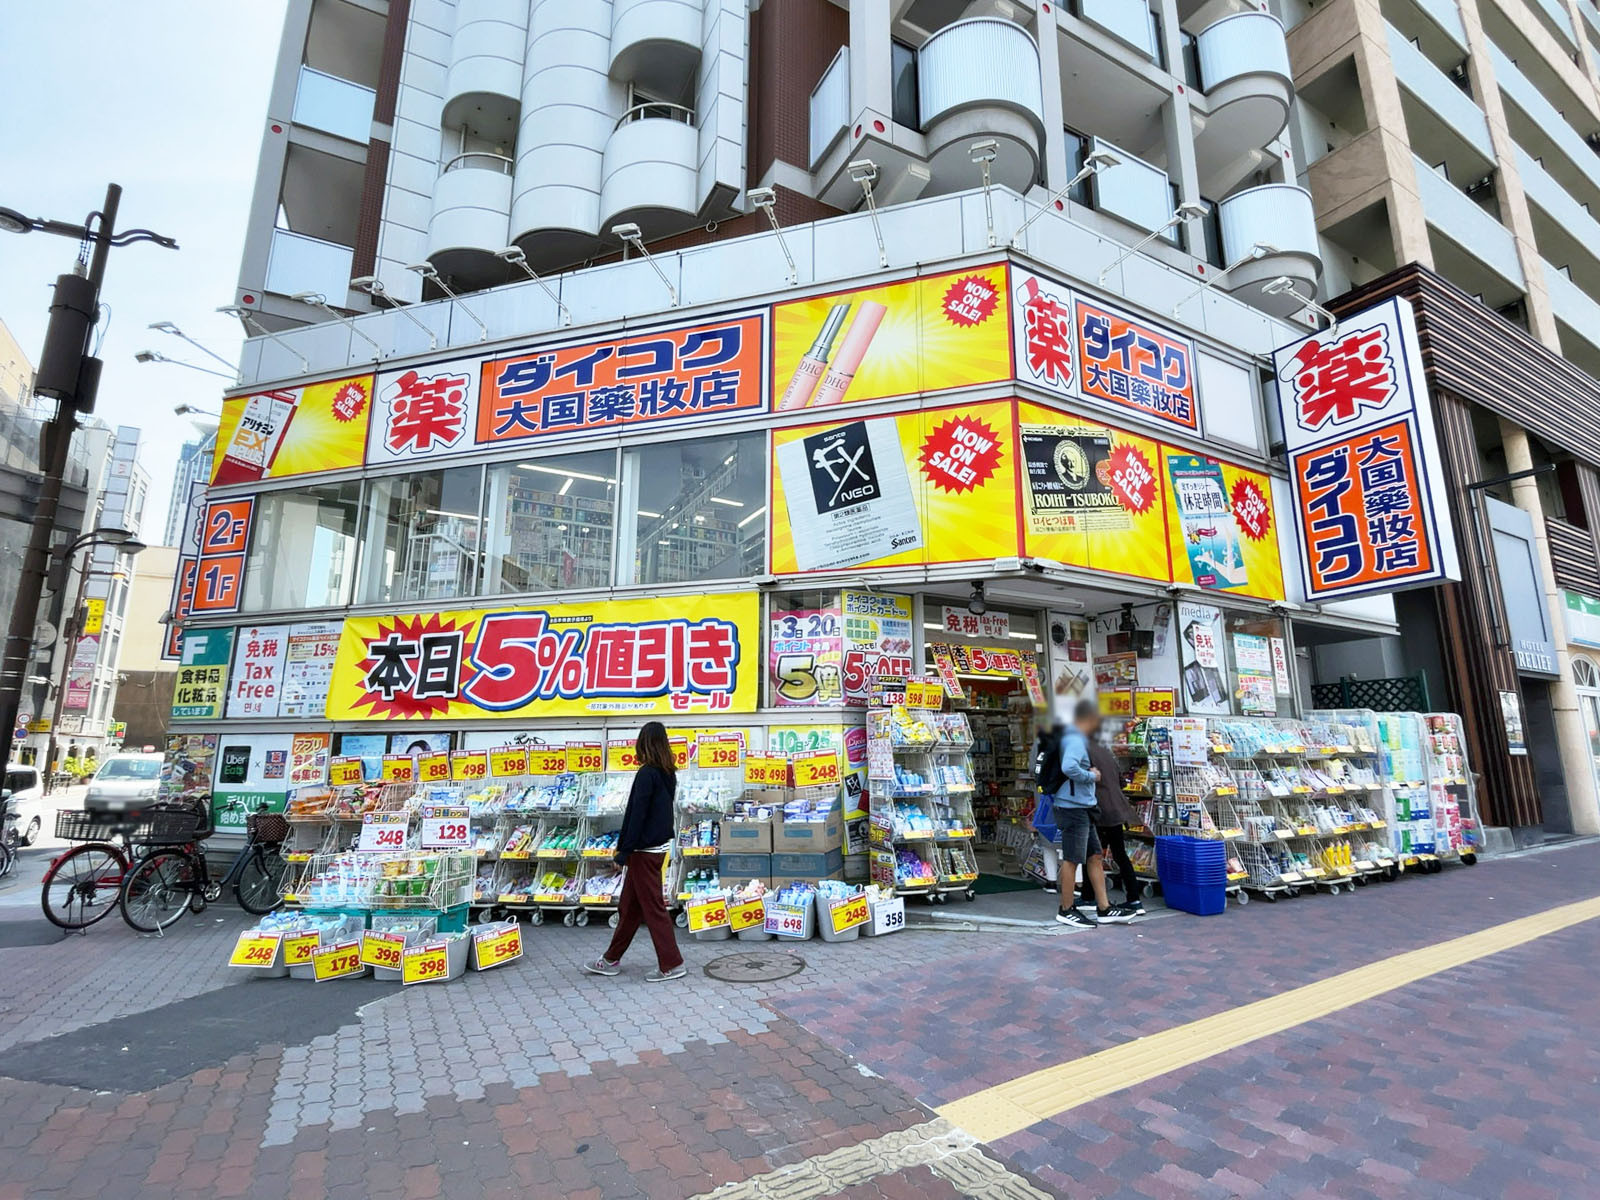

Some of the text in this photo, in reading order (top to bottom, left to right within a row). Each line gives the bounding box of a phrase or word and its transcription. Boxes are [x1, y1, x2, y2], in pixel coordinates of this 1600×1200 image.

[964, 281, 993, 301] NOW
[948, 300, 982, 322] SALE!
[962, 294, 982, 310] ON
[1021, 277, 1074, 382] 薬
[1082, 311, 1190, 389] ダイコク
[496, 325, 743, 397] ダイコク
[799, 361, 823, 376] DHC
[824, 375, 849, 390] DHC
[1288, 329, 1391, 428] 薬
[344, 396, 356, 408] ON
[347, 387, 364, 403] NOW
[494, 369, 741, 436] 大国藥妝店
[335, 400, 355, 419] SALE!
[388, 371, 470, 450] 薬
[241, 416, 275, 436] アリナミン
[233, 428, 270, 452] EX
[951, 424, 993, 455] NOW
[949, 444, 976, 466] ON
[928, 451, 978, 486] SALE!
[1126, 451, 1152, 485] NOW
[1125, 468, 1143, 491] ON
[841, 484, 875, 502] NEO
[1112, 470, 1144, 509] SALE!
[1184, 491, 1223, 510] 休足時間
[1245, 485, 1266, 514] NOW
[1357, 434, 1419, 573] 大国藥妝店
[1235, 501, 1261, 536] SALE!
[1245, 499, 1260, 520] ON
[1305, 445, 1363, 584] ダイコク
[208, 509, 245, 547] 2F
[204, 564, 235, 603] 1F
[1181, 606, 1211, 619] media
[781, 616, 803, 639] 3日
[807, 614, 841, 637] 20日
[946, 614, 979, 634] 免税
[1095, 613, 1140, 634] EVIA
[182, 636, 209, 665] F
[246, 639, 278, 658] 免税
[775, 641, 811, 652] ポイント
[1520, 639, 1545, 652] HOTEL
[366, 633, 463, 698] 本日
[467, 615, 734, 705] 5%値引き
[1518, 651, 1552, 671] RELIEF
[180, 668, 221, 685] 食料品
[244, 662, 274, 680] Tax
[177, 687, 218, 704] 化粧品
[237, 680, 275, 699] Free
[887, 692, 904, 705] 138
[908, 692, 923, 704] 598
[671, 692, 731, 710] セール
[1148, 700, 1172, 712] 88
[295, 737, 322, 752] アプリ
[226, 754, 246, 765] Uber
[503, 758, 526, 772] 198
[542, 758, 566, 772] 328
[578, 755, 602, 768] 198
[712, 749, 738, 763] 198
[224, 765, 244, 775] Eats
[343, 769, 360, 781] 118
[392, 767, 411, 779] 98
[429, 763, 448, 777] 88
[463, 763, 486, 776] 498
[749, 768, 765, 780] 398
[769, 768, 786, 780] 498
[809, 765, 838, 780] 248
[375, 830, 404, 845] 348
[438, 824, 467, 840] 128
[704, 908, 726, 922] 68
[742, 908, 765, 922] 98
[845, 904, 867, 923] 248
[885, 912, 903, 927] 358
[783, 917, 802, 931] 698
[245, 947, 273, 960] 248
[374, 947, 400, 963] 398
[494, 939, 520, 957] 58
[330, 954, 360, 971] 178
[418, 959, 446, 975] 398
